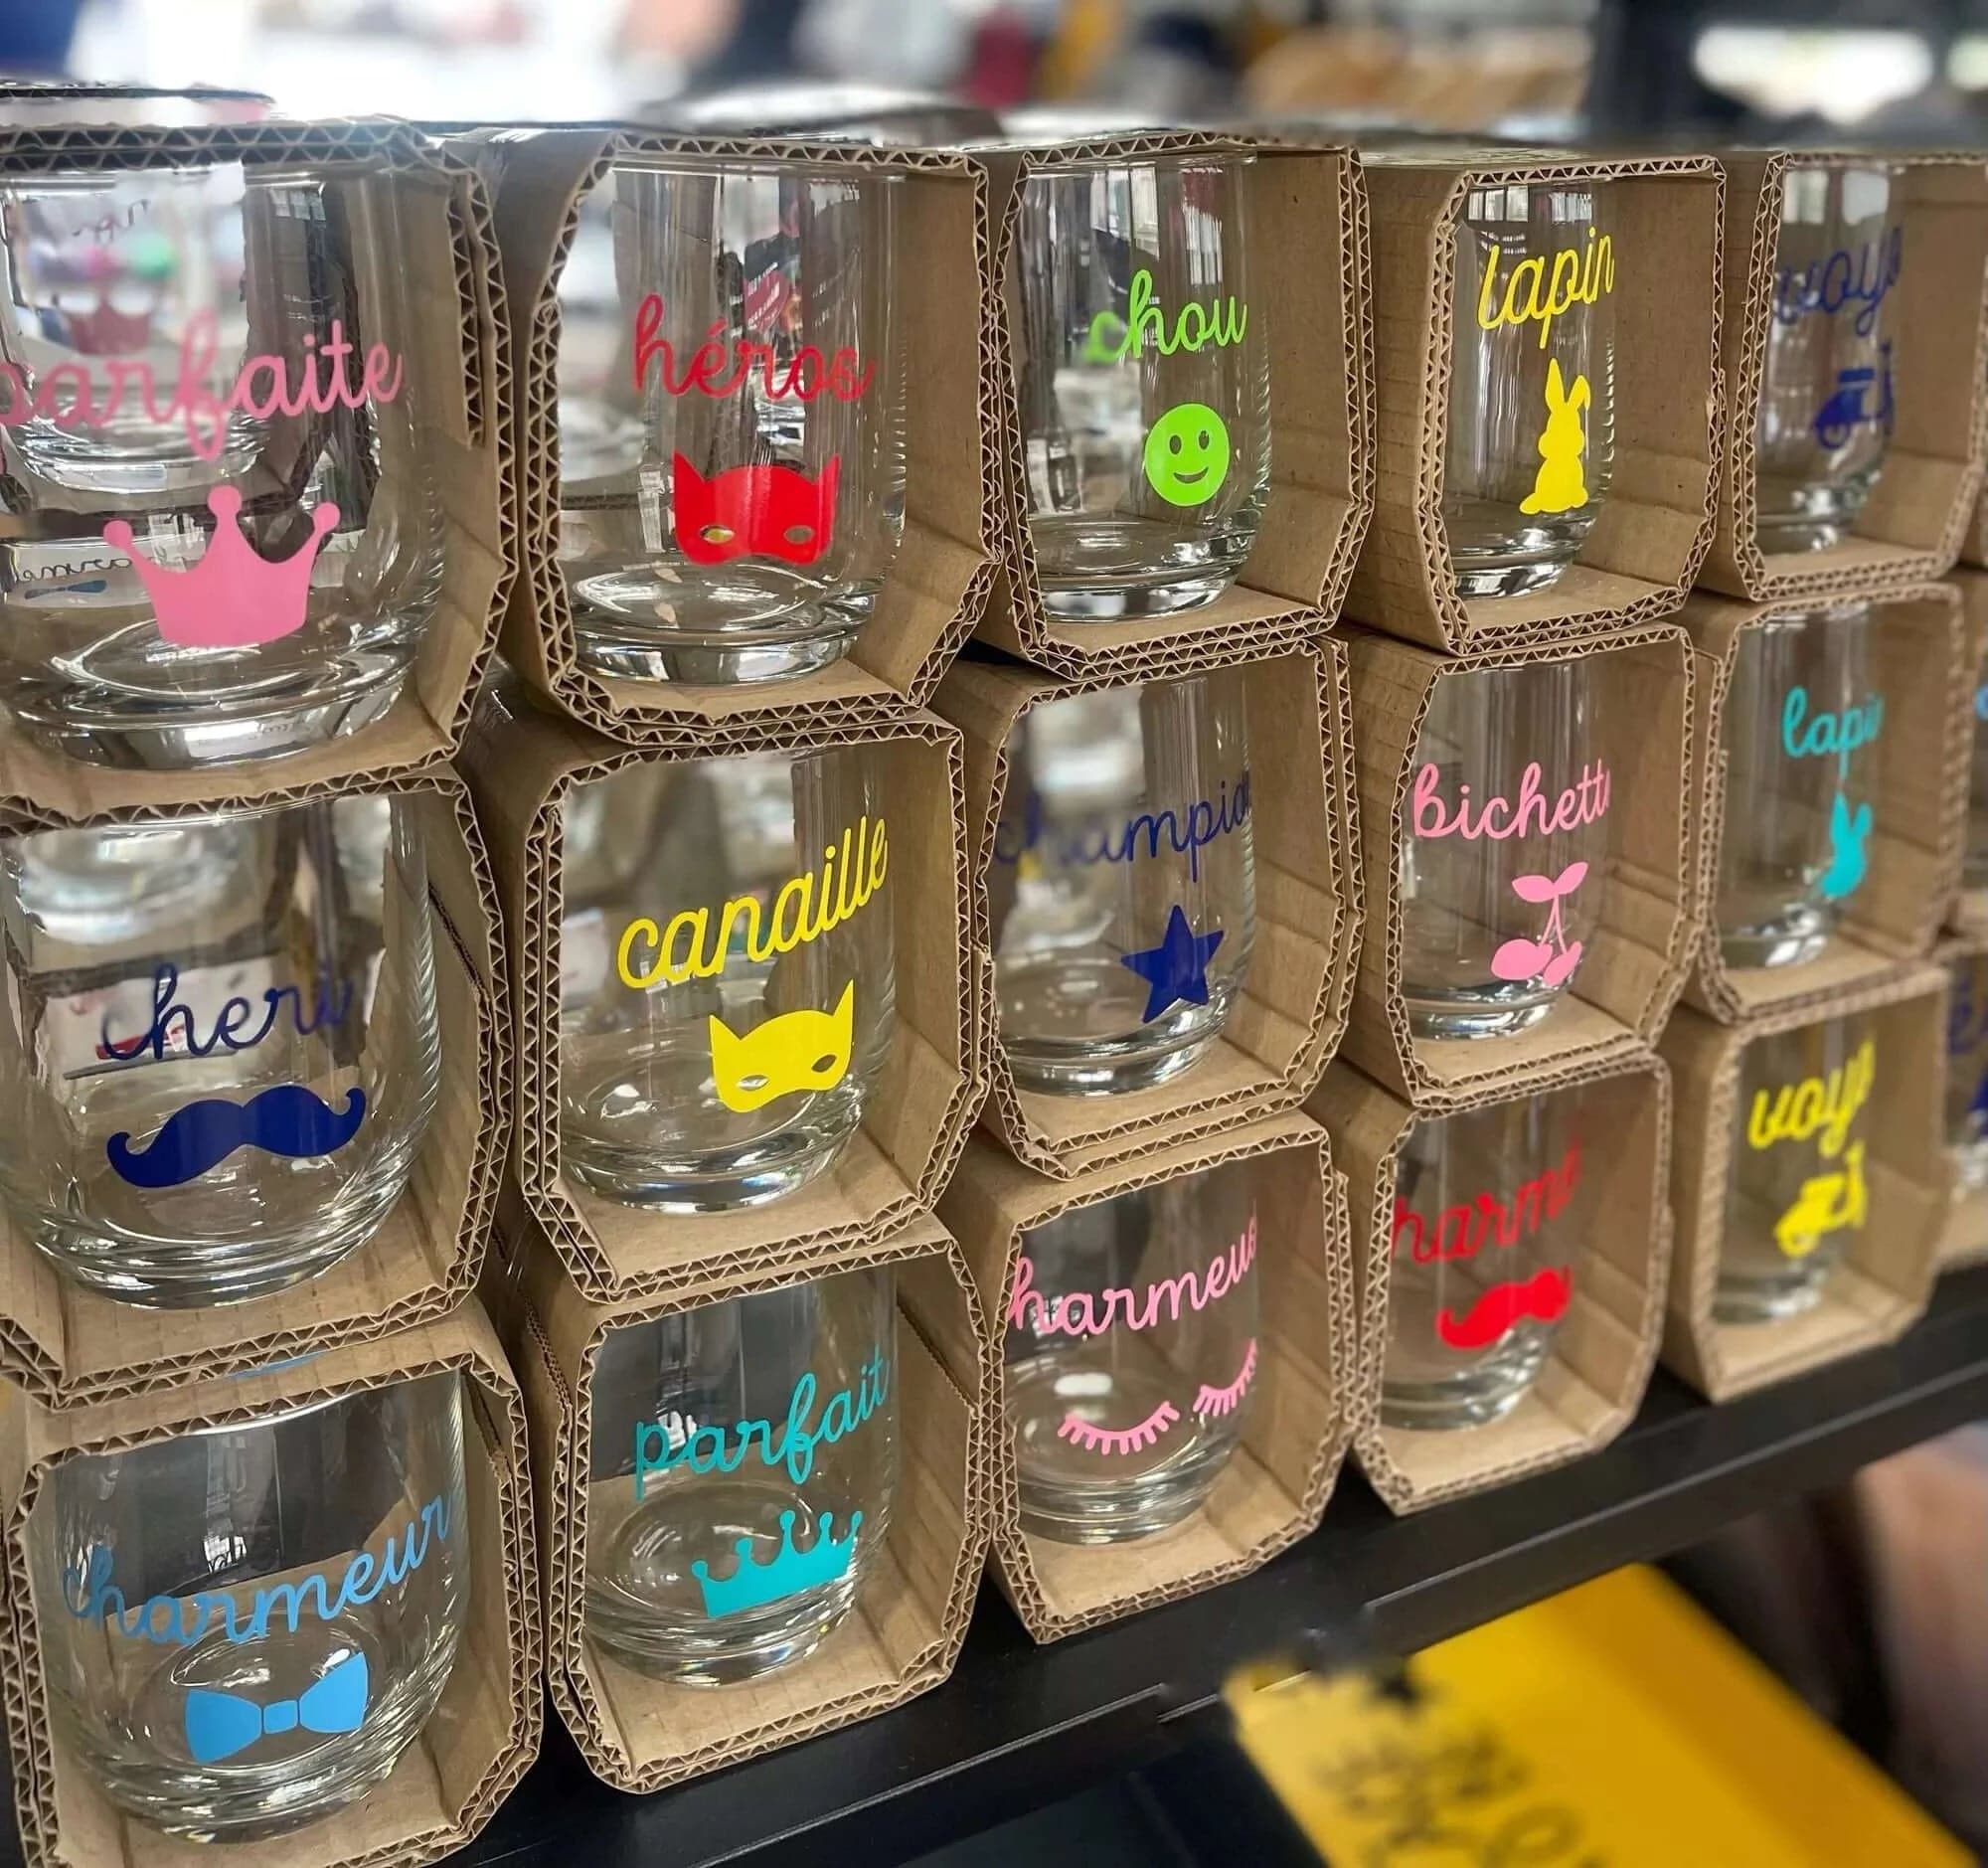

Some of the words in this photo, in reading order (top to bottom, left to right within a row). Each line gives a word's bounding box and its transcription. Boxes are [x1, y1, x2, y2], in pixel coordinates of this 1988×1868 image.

[633, 292, 876, 402] héros
[1082, 268, 1247, 363] chou
[1477, 227, 1614, 349] lapin
[617, 815, 888, 988] canaille
[636, 1342, 891, 1501] parfait
[63, 1493, 451, 1645] charmeur
